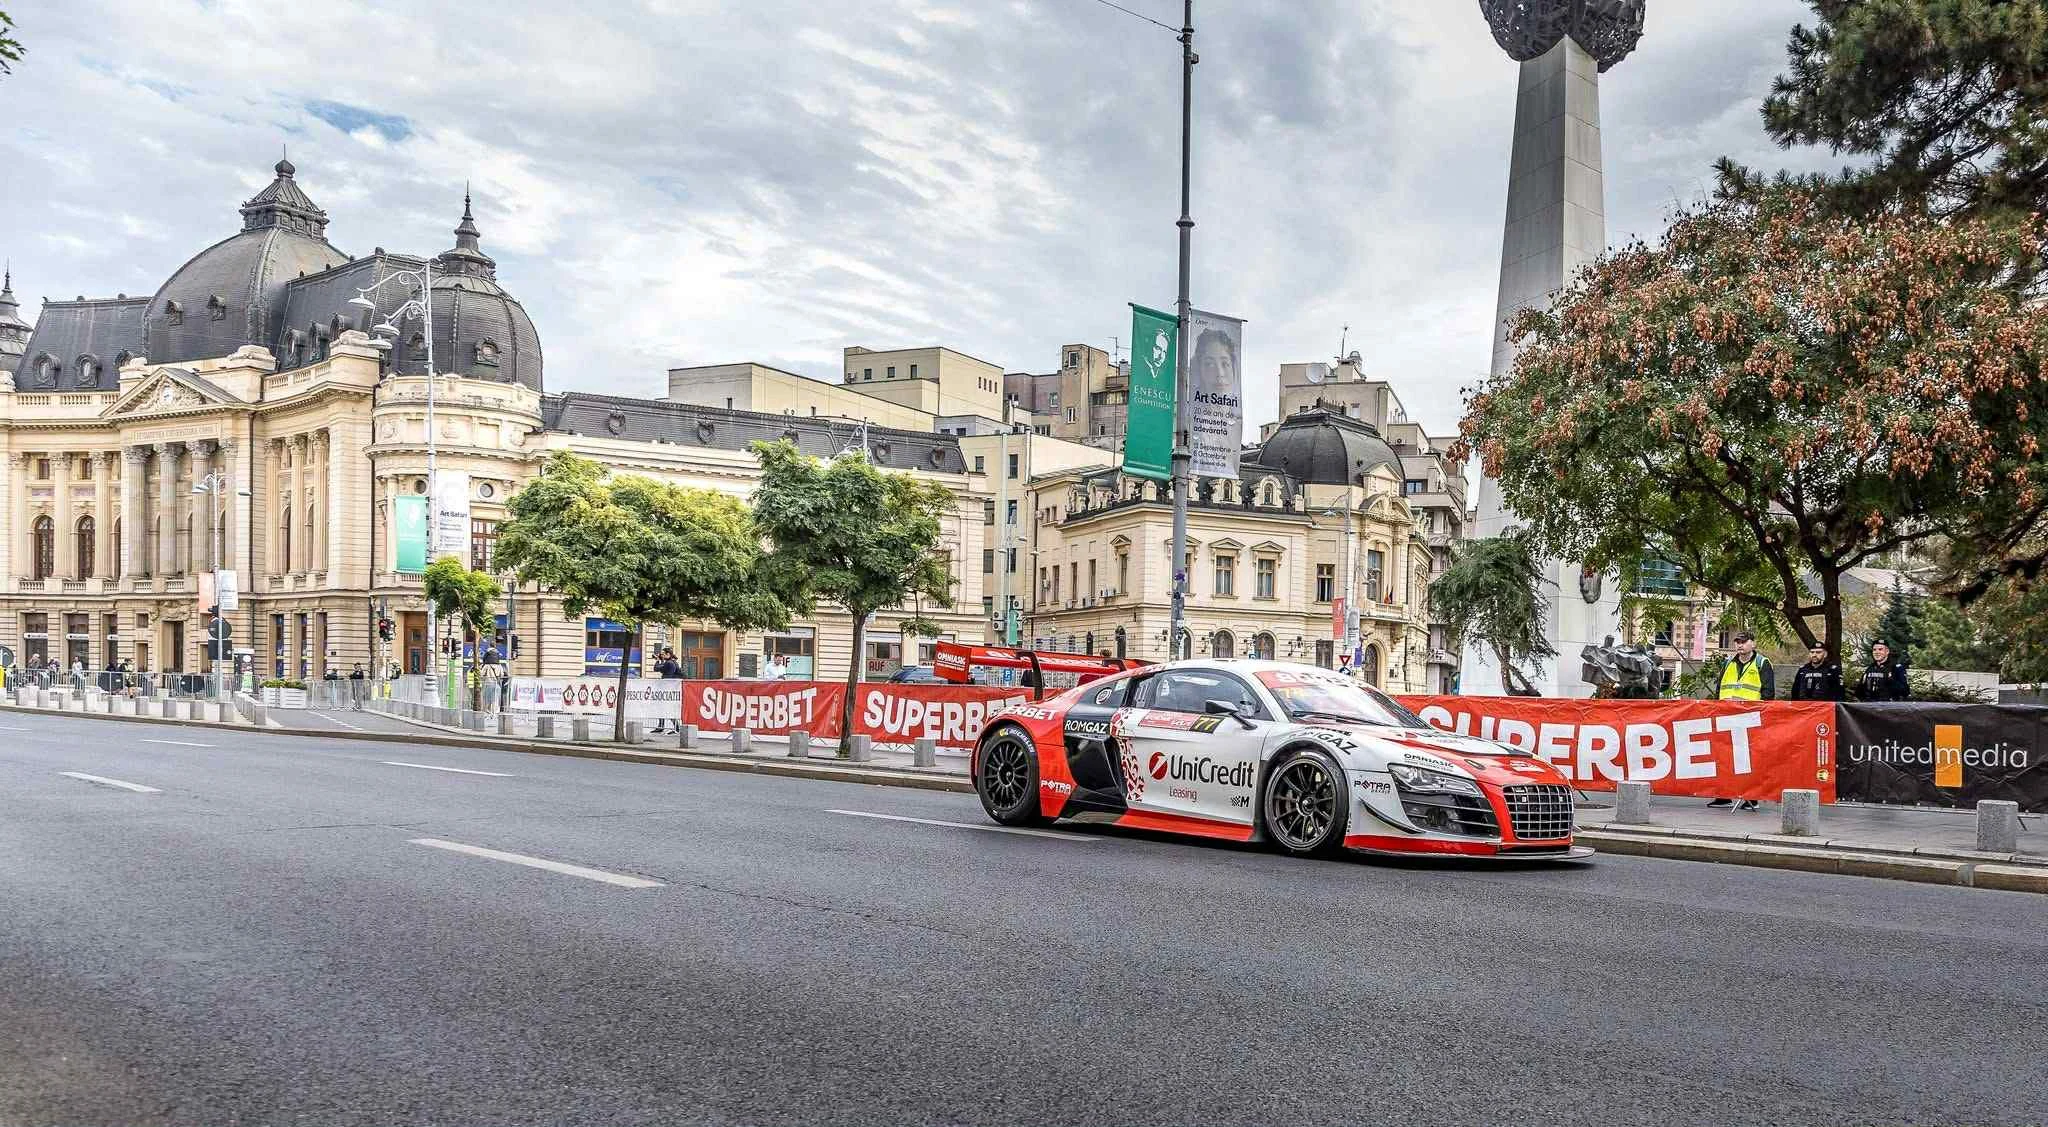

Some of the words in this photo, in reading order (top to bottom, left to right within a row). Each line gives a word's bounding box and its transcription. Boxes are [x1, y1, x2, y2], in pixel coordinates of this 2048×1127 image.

[1194, 391, 1208, 404] Art
[1211, 393, 1238, 407] Safari
[700, 687, 817, 729] SUPERBET
[1064, 720, 1108, 734] ROMGAZ
[1194, 717, 1218, 731] 77
[1850, 739, 2028, 768] unitedmedia
[1170, 755, 1254, 788] UniCredit
[1169, 786, 1197, 803] Leasing
